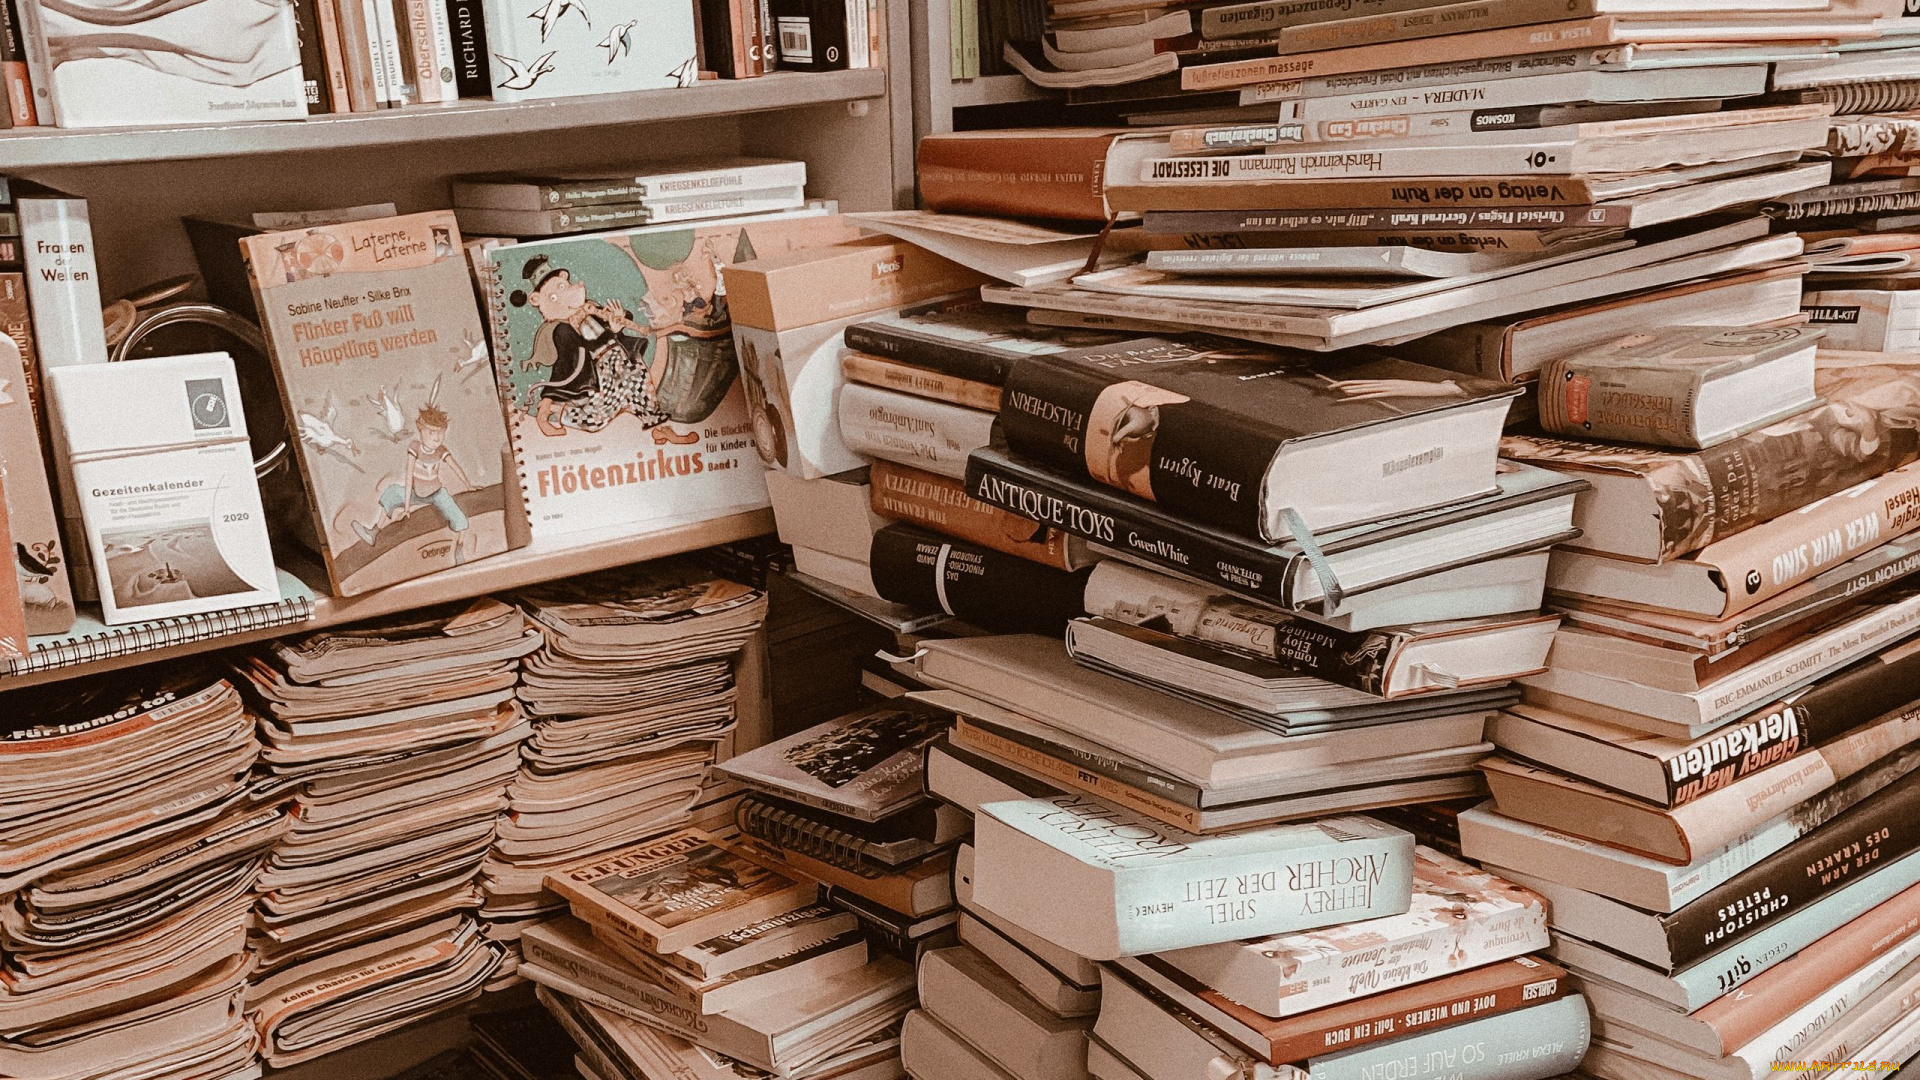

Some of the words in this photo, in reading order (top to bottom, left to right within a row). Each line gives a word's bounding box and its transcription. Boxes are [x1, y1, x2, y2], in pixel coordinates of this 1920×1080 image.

[1220, 6, 1275, 26] Giganten
[458, 6, 478, 79] RICHARD
[1268, 60, 1314, 76] massage
[1406, 68, 1422, 81] mit
[1423, 60, 1512, 79] Bildergeschichten
[1349, 98, 1389, 112] GARTEN
[1391, 96, 1408, 108] EIN
[1423, 86, 1486, 105] MADEIRA
[1328, 121, 1354, 138] Can
[1354, 118, 1409, 136] Checker
[1475, 112, 1516, 126] KOSMOS
[1204, 128, 1279, 147] Checkerbuch
[1279, 126, 1303, 143] Das
[1152, 160, 1208, 178] LESESTADT
[1211, 159, 1230, 177] DIE
[1239, 157, 1297, 176] Rütimann
[1300, 152, 1382, 174] Hansheinrich
[659, 174, 743, 193] KRIEGSENKELGEFÜHLE
[1467, 185, 1493, 199] an
[1497, 180, 1565, 202] Verlag
[1390, 188, 1430, 204] Ruhr
[1434, 187, 1464, 202] der
[664, 197, 744, 215] KRIEGSENKELGEFÜHLE
[1516, 210, 1565, 223] Christel
[1279, 215, 1309, 228] selbst
[1310, 216, 1323, 225] es
[1390, 212, 1420, 225] Kraft
[1422, 212, 1468, 225] Gertrud
[351, 226, 412, 252] Laterne,
[1458, 233, 1508, 250] Verlag
[373, 238, 428, 263] Laterne
[1161, 253, 1198, 264] revolution
[1200, 252, 1232, 265] digitalen
[1257, 252, 1286, 264] während
[287, 302, 323, 317] Sabine
[366, 289, 391, 304] Silke
[392, 283, 412, 299] Brix
[291, 317, 350, 343] Flinker
[352, 309, 385, 331] Fuß
[385, 304, 416, 324] will
[300, 340, 380, 370] Häuptling
[383, 328, 438, 354] werden
[1009, 389, 1083, 432] FÄLSCHERIN
[704, 428, 718, 439] Die
[705, 442, 719, 454] für
[720, 440, 748, 452] Kinder
[537, 450, 704, 498] Flötenzirkus
[708, 460, 731, 472] Band
[731, 458, 739, 470] 2
[1158, 456, 1203, 488] Rygiert
[1726, 456, 1740, 484] Das
[92, 478, 205, 498] Gezeitenkalender
[882, 473, 970, 508] GEFÜRCHTETEN
[1206, 473, 1241, 502] Beate
[882, 496, 926, 519] FRANKLIN
[978, 472, 1064, 525] ANTIQUE
[1065, 502, 1116, 543] TOYS
[1884, 486, 1919, 519] Hensel
[222, 512, 250, 522] 2020
[927, 508, 948, 525] TOM
[1845, 511, 1880, 552] WER
[421, 542, 452, 561] Oetinger
[915, 543, 939, 555] ZEMAN
[1127, 531, 1158, 556] Gwen
[1157, 538, 1190, 566] White
[1811, 527, 1842, 565] WIR
[916, 554, 935, 566] DAVID
[947, 559, 985, 576] PINOCCHIO-
[949, 550, 983, 564] SYNDROM
[1772, 547, 1808, 586] SIND
[946, 570, 959, 581] DAS
[1216, 561, 1263, 583] CHANCELLOR
[1843, 570, 1874, 597] 1517
[1281, 635, 1312, 654] Eloy
[1280, 647, 1319, 668] Tomás
[1713, 668, 1786, 710] ERIC-EMMANUEL
[1785, 653, 1823, 681] SCHMITT
[1827, 646, 1842, 659] The
[12, 724, 51, 740] Für
[58, 704, 138, 735] immer
[141, 691, 176, 710] tot
[1669, 706, 1800, 782] Verkaufen
[1738, 735, 1800, 775] Clancy
[1077, 771, 1099, 786] FETT
[1674, 764, 1736, 806] Martin
[1745, 771, 1803, 813] kinderreich
[1864, 827, 1890, 845] DES
[1805, 839, 1861, 878] KRAKEN
[1855, 847, 1880, 869] DER
[1236, 870, 1276, 895] DER
[1286, 852, 1389, 892] ARCHER
[1819, 861, 1850, 885] ARM
[1181, 877, 1229, 903] ZEIT
[1298, 873, 1374, 917] JEFFREY
[1142, 902, 1175, 916] HEYNE
[1203, 898, 1257, 925] SPIEL
[1717, 886, 1771, 922] PETERS
[1512, 917, 1525, 927] de
[1703, 893, 1790, 945] CHRISTOPH
[1388, 937, 1433, 954] Madame
[1754, 941, 1788, 967] GEGEN
[1340, 946, 1388, 970] Jeanne
[1412, 960, 1430, 976] Die
[281, 986, 317, 1005] Keine
[316, 975, 359, 993] Chance
[359, 966, 374, 982] für
[376, 954, 417, 973] Carson
[1347, 966, 1380, 992] Welt
[1381, 962, 1412, 985] kleine
[1717, 954, 1752, 993] gift
[1521, 980, 1558, 1001] CARLSEN
[1451, 998, 1471, 1016] UND
[1472, 992, 1497, 1013] DOYÉ
[1828, 992, 1849, 1018] AM
[1404, 1004, 1449, 1027] WIEMERS
[1323, 1027, 1351, 1048] BUCH
[1353, 1023, 1371, 1041] EIN
[1372, 1017, 1396, 1037] Toll!
[1774, 1012, 1829, 1063] ABGRUND
[1420, 1045, 1458, 1072] AUF
[1461, 1041, 1486, 1064] SO
[1497, 1047, 1530, 1066] KRIELE
[1531, 1040, 1564, 1060] ALEXA
[1361, 1057, 1418, 1080] ERDEN
